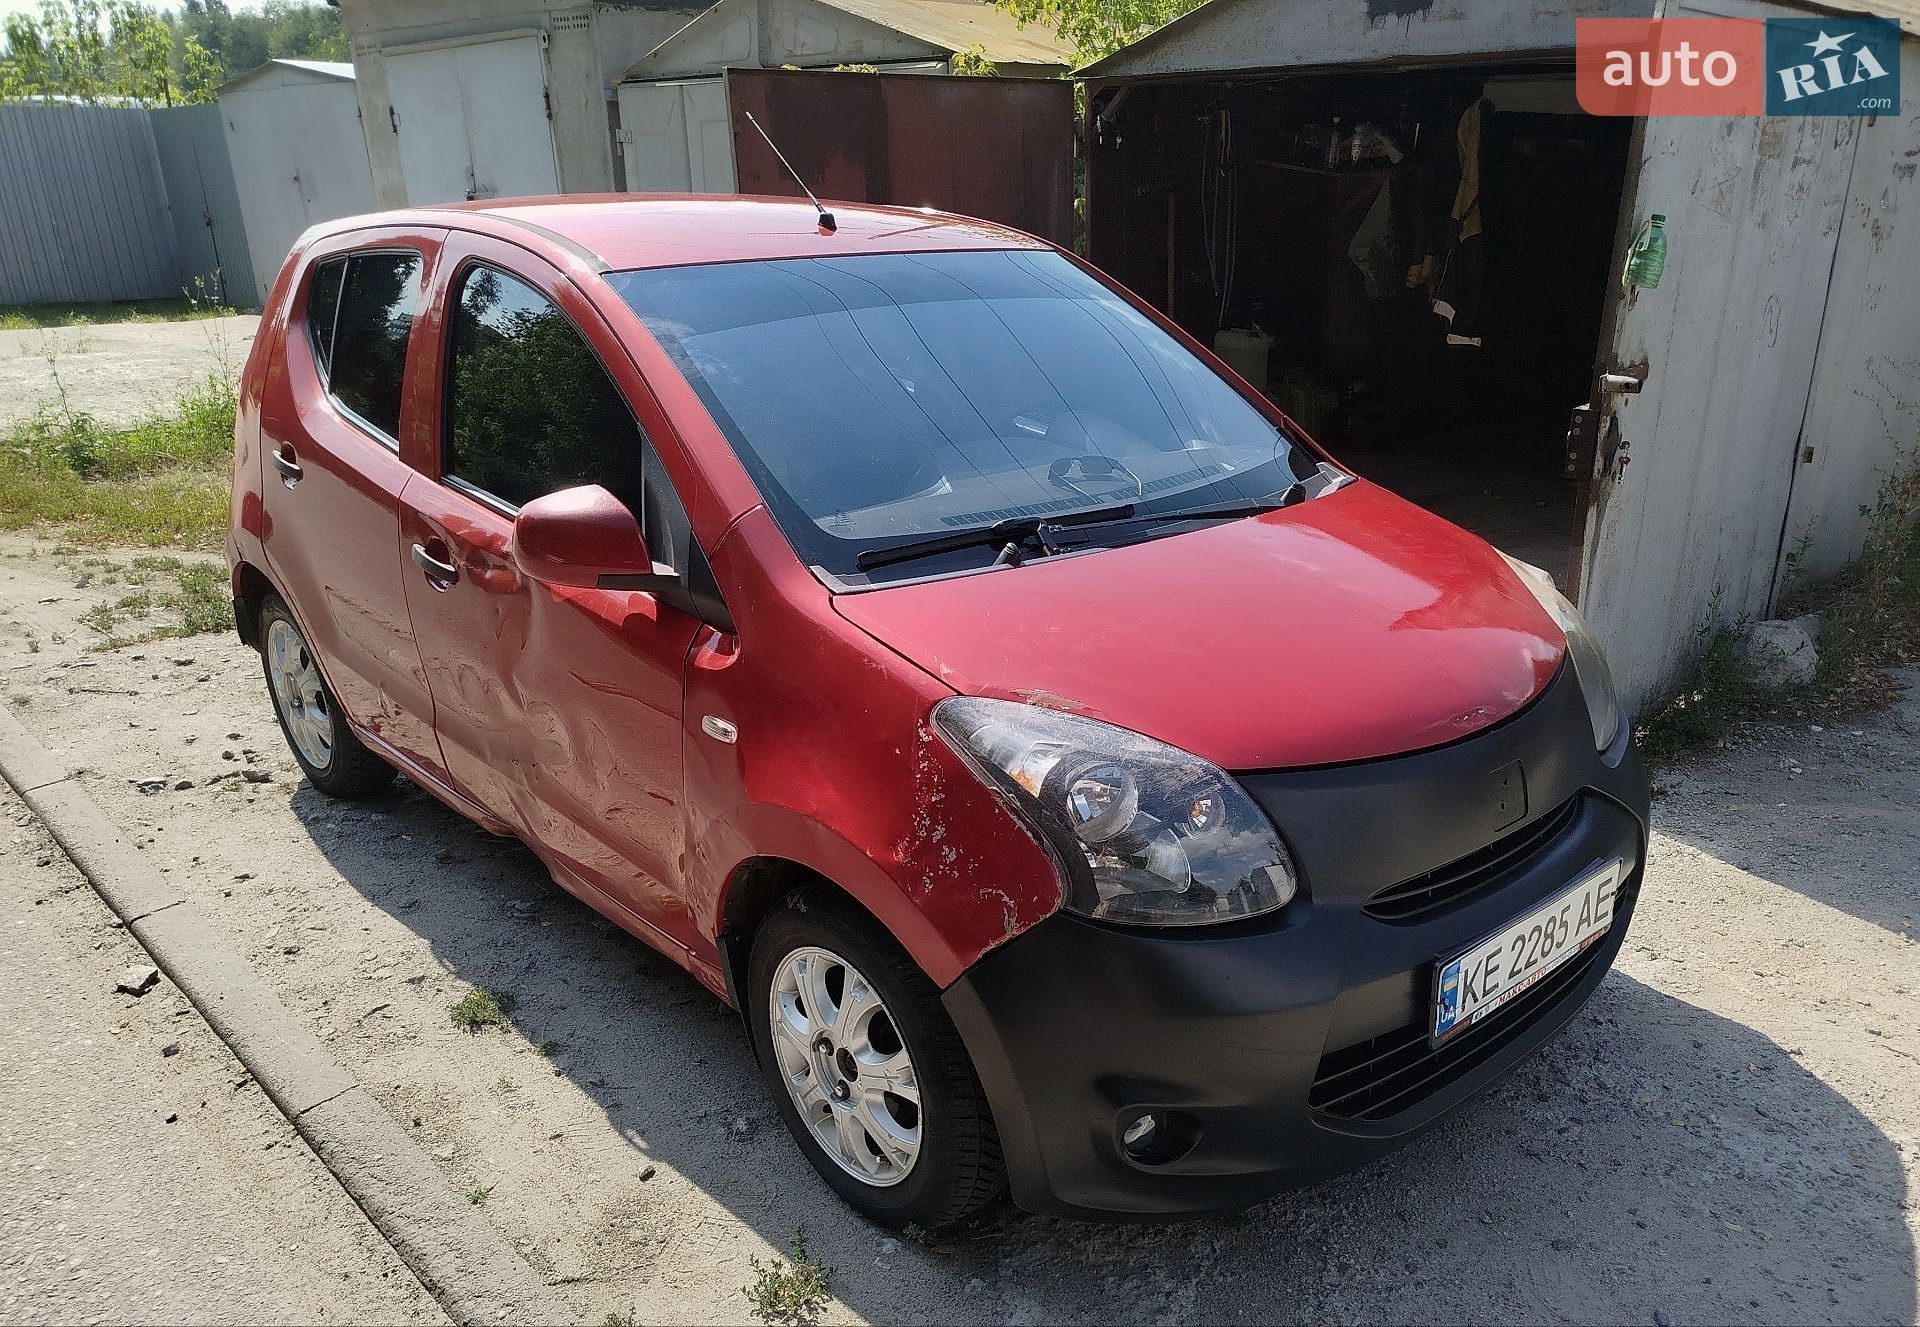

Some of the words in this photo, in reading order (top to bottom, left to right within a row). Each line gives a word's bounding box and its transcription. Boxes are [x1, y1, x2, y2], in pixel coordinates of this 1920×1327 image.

[1461, 946, 1502, 1014] KE
[1507, 904, 1571, 981] 2285
[1574, 876, 1613, 937] AE
[1440, 1004, 1456, 1024] UA
